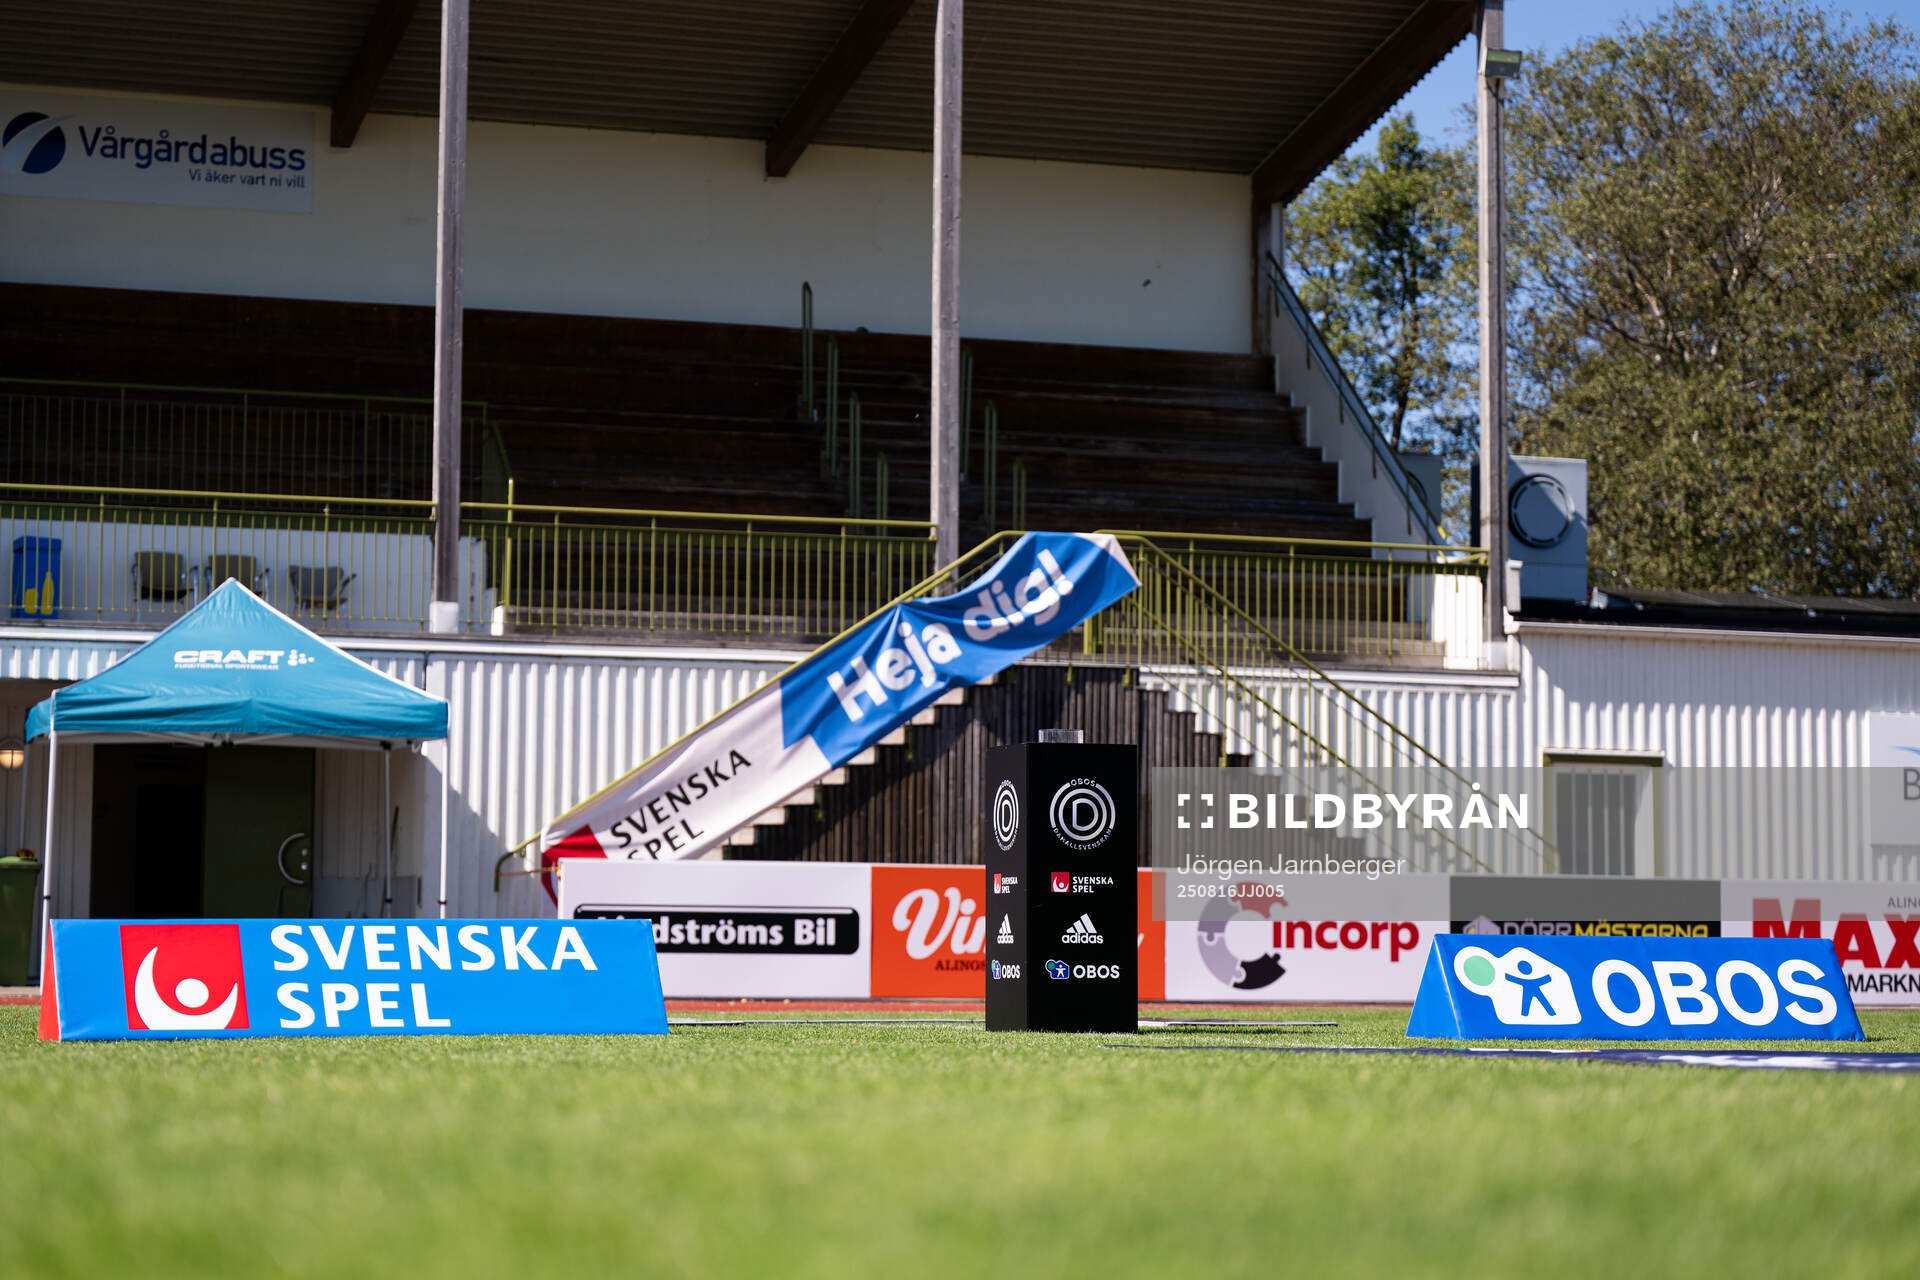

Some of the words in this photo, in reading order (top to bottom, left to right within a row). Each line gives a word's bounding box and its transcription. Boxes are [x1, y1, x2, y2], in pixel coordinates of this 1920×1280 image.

[78, 125, 306, 170] Vårgårdabuss
[188, 168, 201, 182] Vi
[204, 170, 236, 184] åker
[239, 174, 266, 186] vart
[269, 176, 283, 187] ni
[285, 176, 305, 188] vill
[827, 622, 963, 722] Heja
[963, 548, 1074, 642] dig!
[174, 650, 285, 664] CRAFT
[1070, 778, 1096, 787] OBOS
[610, 749, 752, 848] SVENSKA
[1053, 827, 1112, 851] DAMALLSVENSKAN
[1072, 876, 1114, 885] SVENSKA
[1072, 885, 1094, 893] SPEL
[1887, 897, 1920, 909] ALIN
[597, 914, 784, 945] dströms
[794, 917, 836, 946] Bil
[1061, 932, 1104, 944] adidas
[1273, 919, 1420, 962] incorp
[270, 924, 598, 972] SVENSKA
[1001, 965, 1020, 979] OBOS
[1072, 964, 1120, 979] OBOS
[1591, 959, 1838, 1027] OBOS
[276, 982, 452, 1029] SPEL
